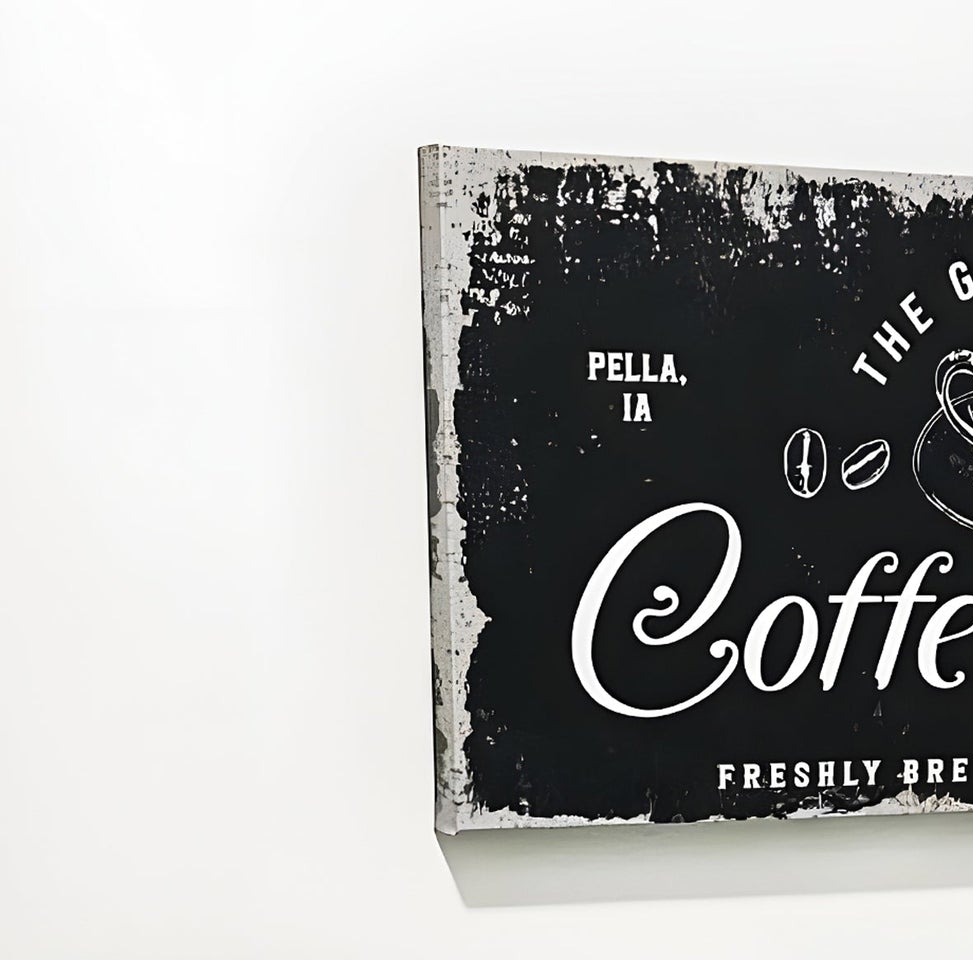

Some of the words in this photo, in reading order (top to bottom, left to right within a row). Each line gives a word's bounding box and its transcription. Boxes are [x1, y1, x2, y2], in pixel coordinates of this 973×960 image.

[852, 291, 934, 386] THE
[587, 351, 688, 387] PELLA,
[622, 392, 653, 422] IA
[717, 760, 882, 789] FRESHLY
